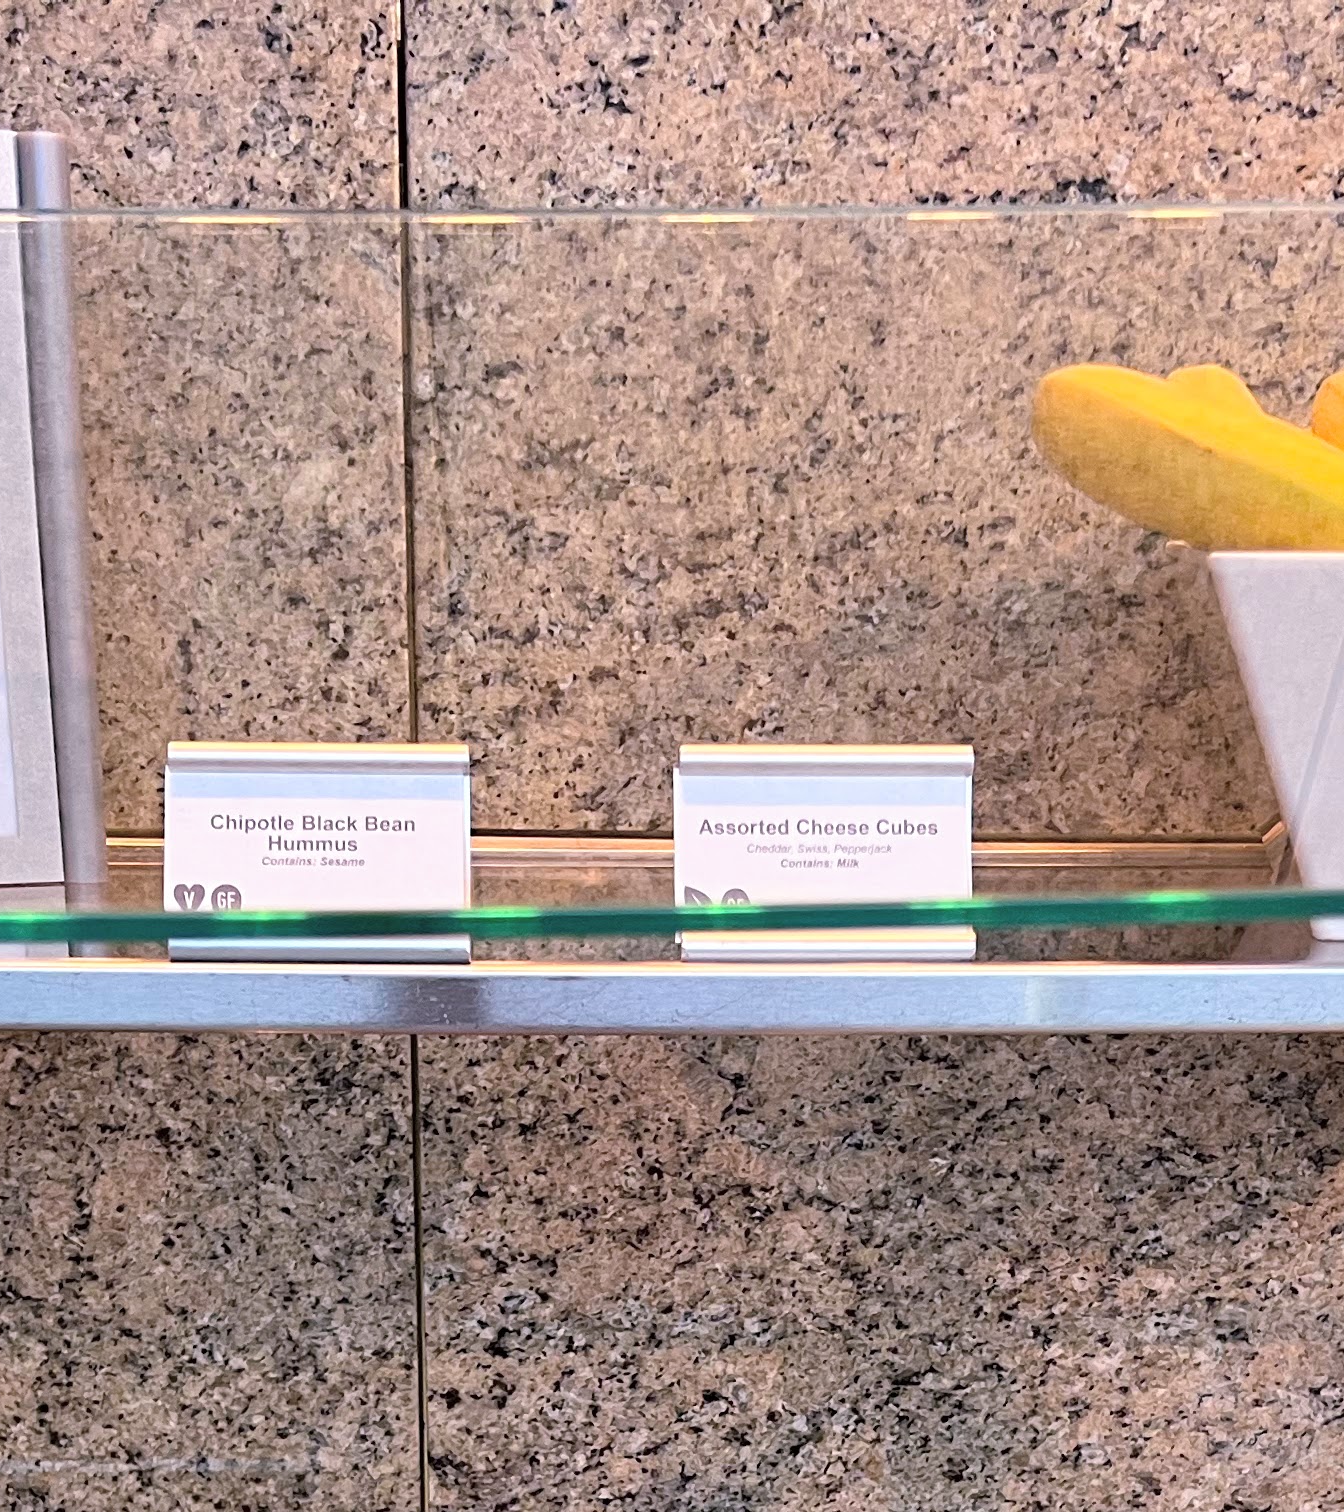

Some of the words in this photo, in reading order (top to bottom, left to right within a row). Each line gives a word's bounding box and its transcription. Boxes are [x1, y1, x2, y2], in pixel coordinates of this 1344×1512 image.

[210, 814, 295, 834] Chipotle
[302, 814, 358, 832] Black
[364, 815, 417, 832] Bean
[699, 819, 789, 836] Assorted
[796, 819, 870, 836] Cheese
[876, 819, 939, 836] Cubes
[267, 835, 359, 852] Hummus
[261, 856, 316, 867] Contains:
[320, 856, 366, 867] Sesame
[780, 858, 833, 869] Contains:
[837, 858, 860, 868] Milk
